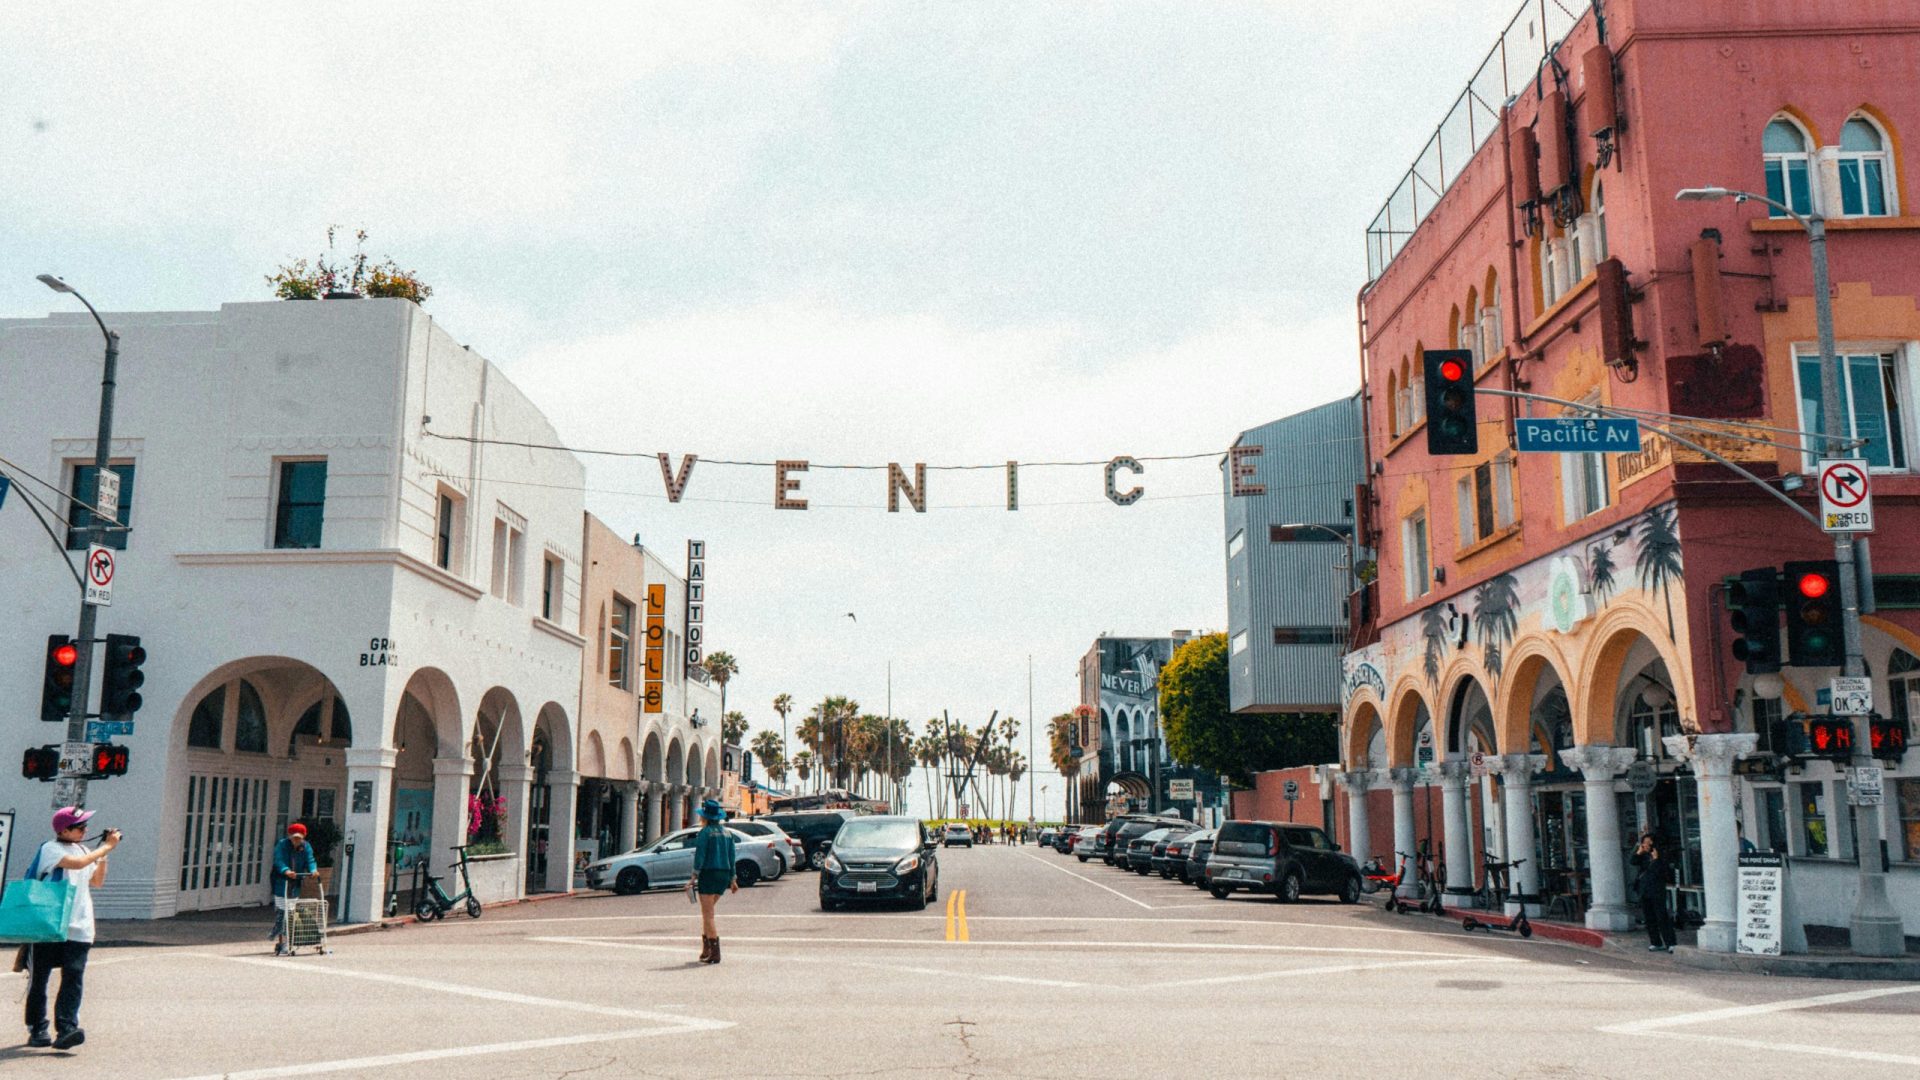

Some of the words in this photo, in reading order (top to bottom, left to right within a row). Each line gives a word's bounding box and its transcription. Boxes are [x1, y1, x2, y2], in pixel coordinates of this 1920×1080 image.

[1527, 425, 1599, 443] Pacific
[1606, 426, 1630, 443] Av
[657, 445, 1266, 513] VENICE
[1846, 513, 1868, 524] RED
[98, 589, 110, 601] RED
[689, 542, 702, 663] TATTOO
[1101, 673, 1141, 693] NEVER
[1834, 697, 1850, 711] OK
